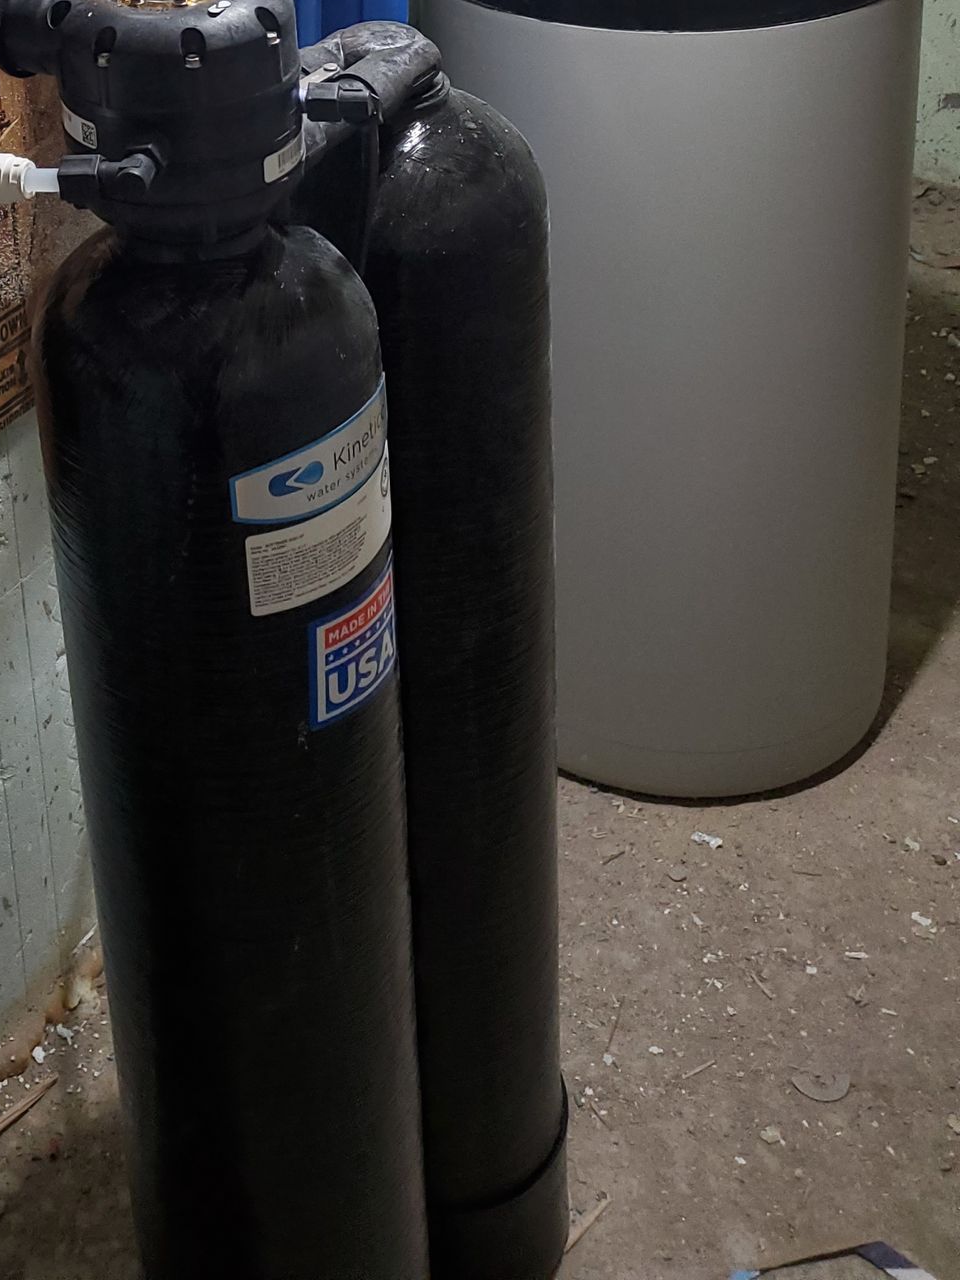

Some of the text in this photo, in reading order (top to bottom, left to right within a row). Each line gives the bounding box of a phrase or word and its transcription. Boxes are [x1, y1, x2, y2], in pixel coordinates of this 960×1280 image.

[307, 478, 342, 503] water
[328, 612, 366, 645] MADE
[367, 600, 377, 620] IN
[328, 628, 393, 705] USA
